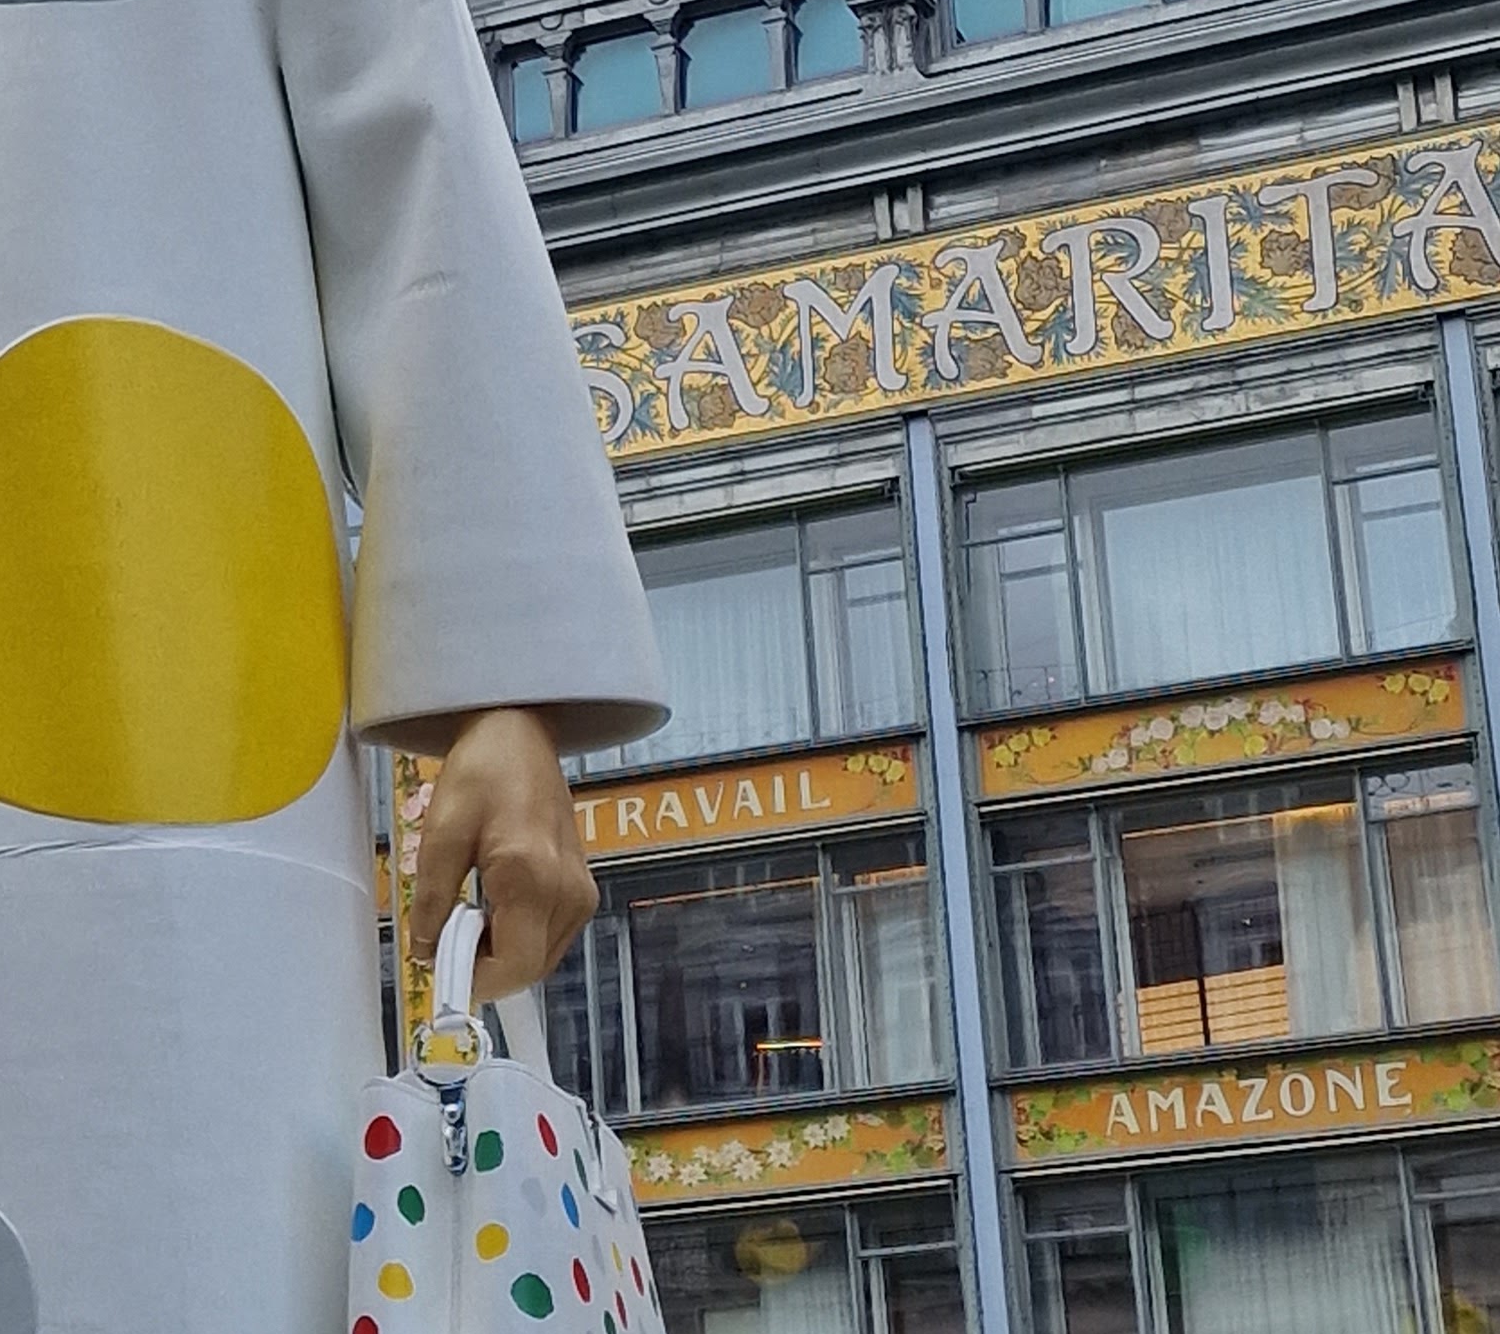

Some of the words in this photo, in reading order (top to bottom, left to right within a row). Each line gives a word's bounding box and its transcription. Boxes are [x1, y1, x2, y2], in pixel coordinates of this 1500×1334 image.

[570, 139, 1500, 445] SAMARITA
[573, 770, 831, 842] TRAVAIL
[1105, 1062, 1412, 1137] AMAZONE
